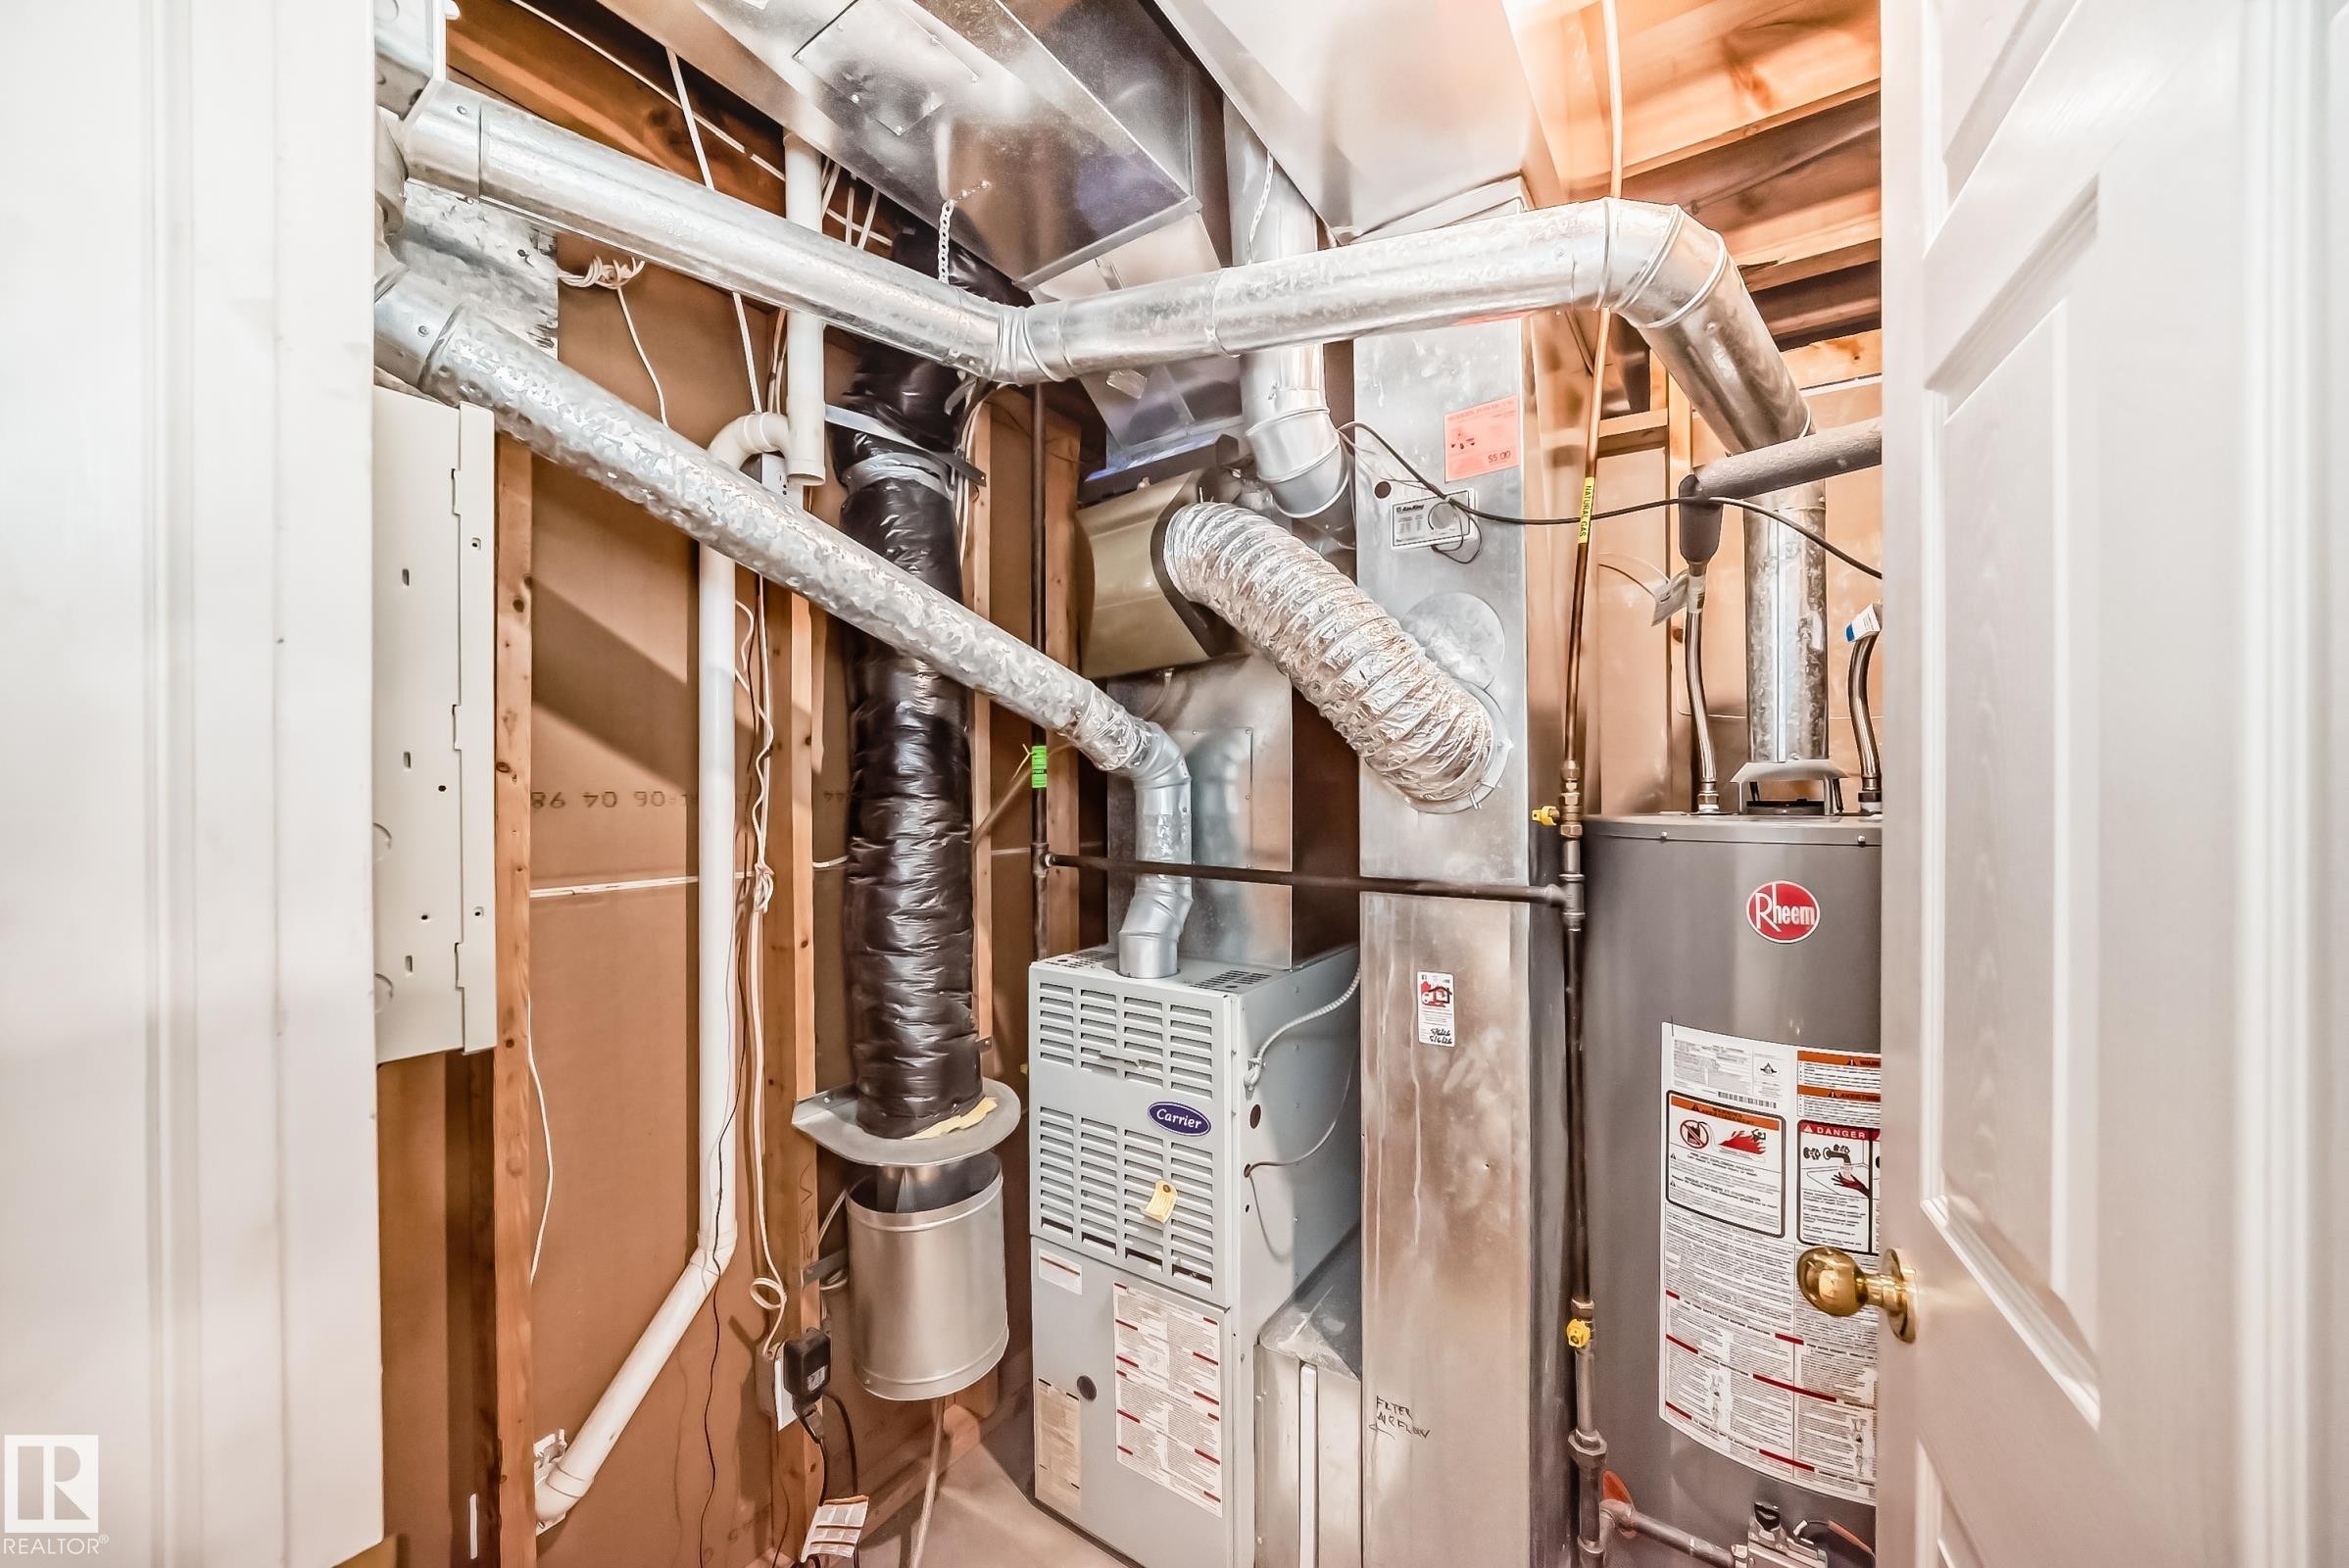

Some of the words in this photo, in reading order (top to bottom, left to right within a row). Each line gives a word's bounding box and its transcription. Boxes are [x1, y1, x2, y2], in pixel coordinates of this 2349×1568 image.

[1581, 485, 1592, 520] NATURAL
[1579, 520, 1588, 537] GAS
[1754, 881, 1816, 933] Rheem
[1155, 1108, 1203, 1130] Carrier
[1816, 1126, 1866, 1139] DANGER
